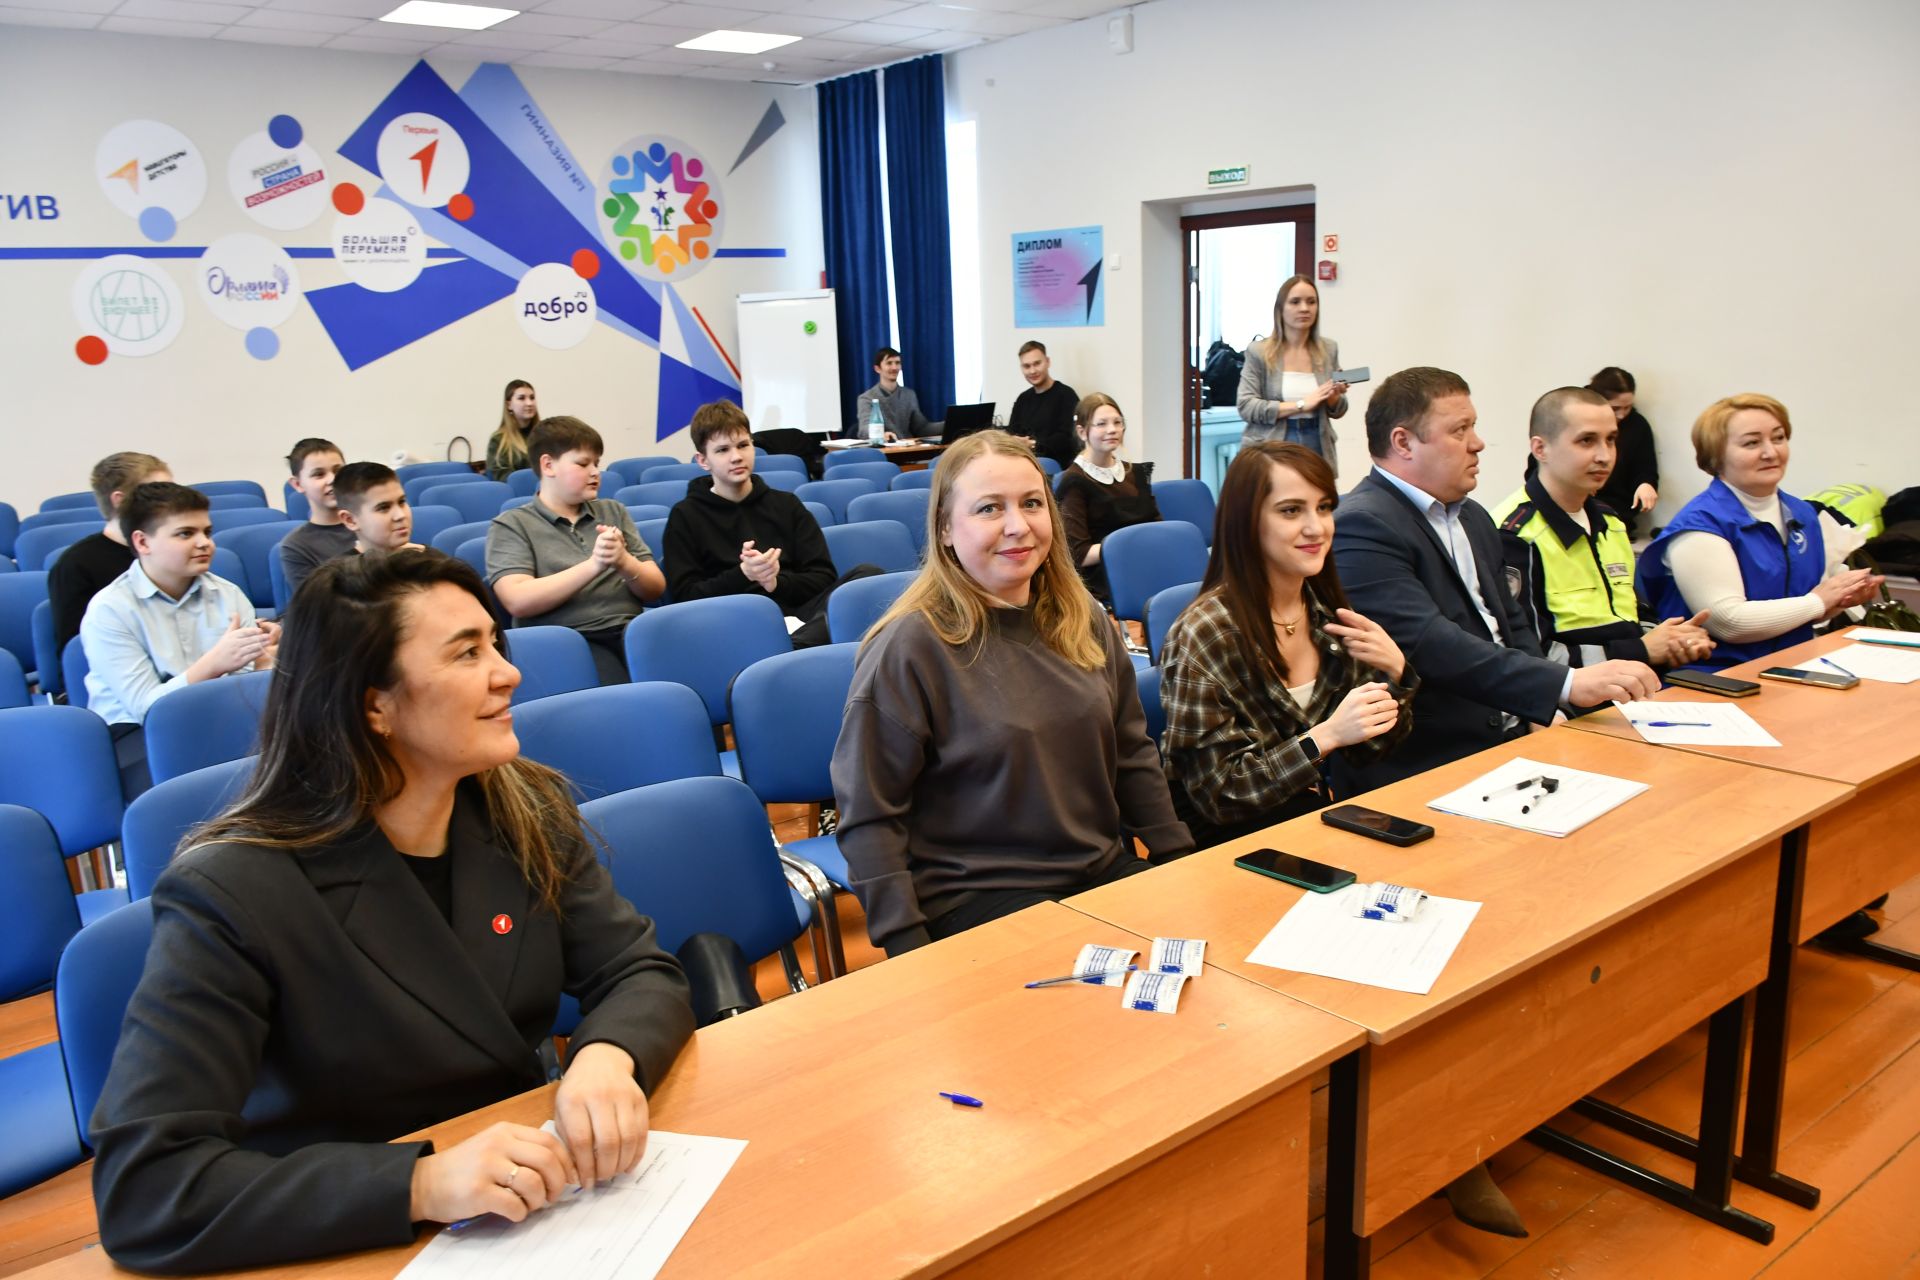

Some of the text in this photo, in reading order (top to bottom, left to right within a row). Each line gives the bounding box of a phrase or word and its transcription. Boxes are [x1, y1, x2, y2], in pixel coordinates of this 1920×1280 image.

[402, 124, 439, 136] Первые
[520, 103, 572, 172] ГИМНАЗИЯ
[264, 167, 301, 188] СТРАНА
[1209, 170, 1246, 183] ВЫХОД
[0, 194, 60, 220] ИВ
[342, 235, 408, 245] БОЛЬШАЯ
[1017, 238, 1063, 253] ДИПЛОМ
[342, 245, 407, 255] ПЕРЕМЕНА
[523, 296, 588, 319] добро
